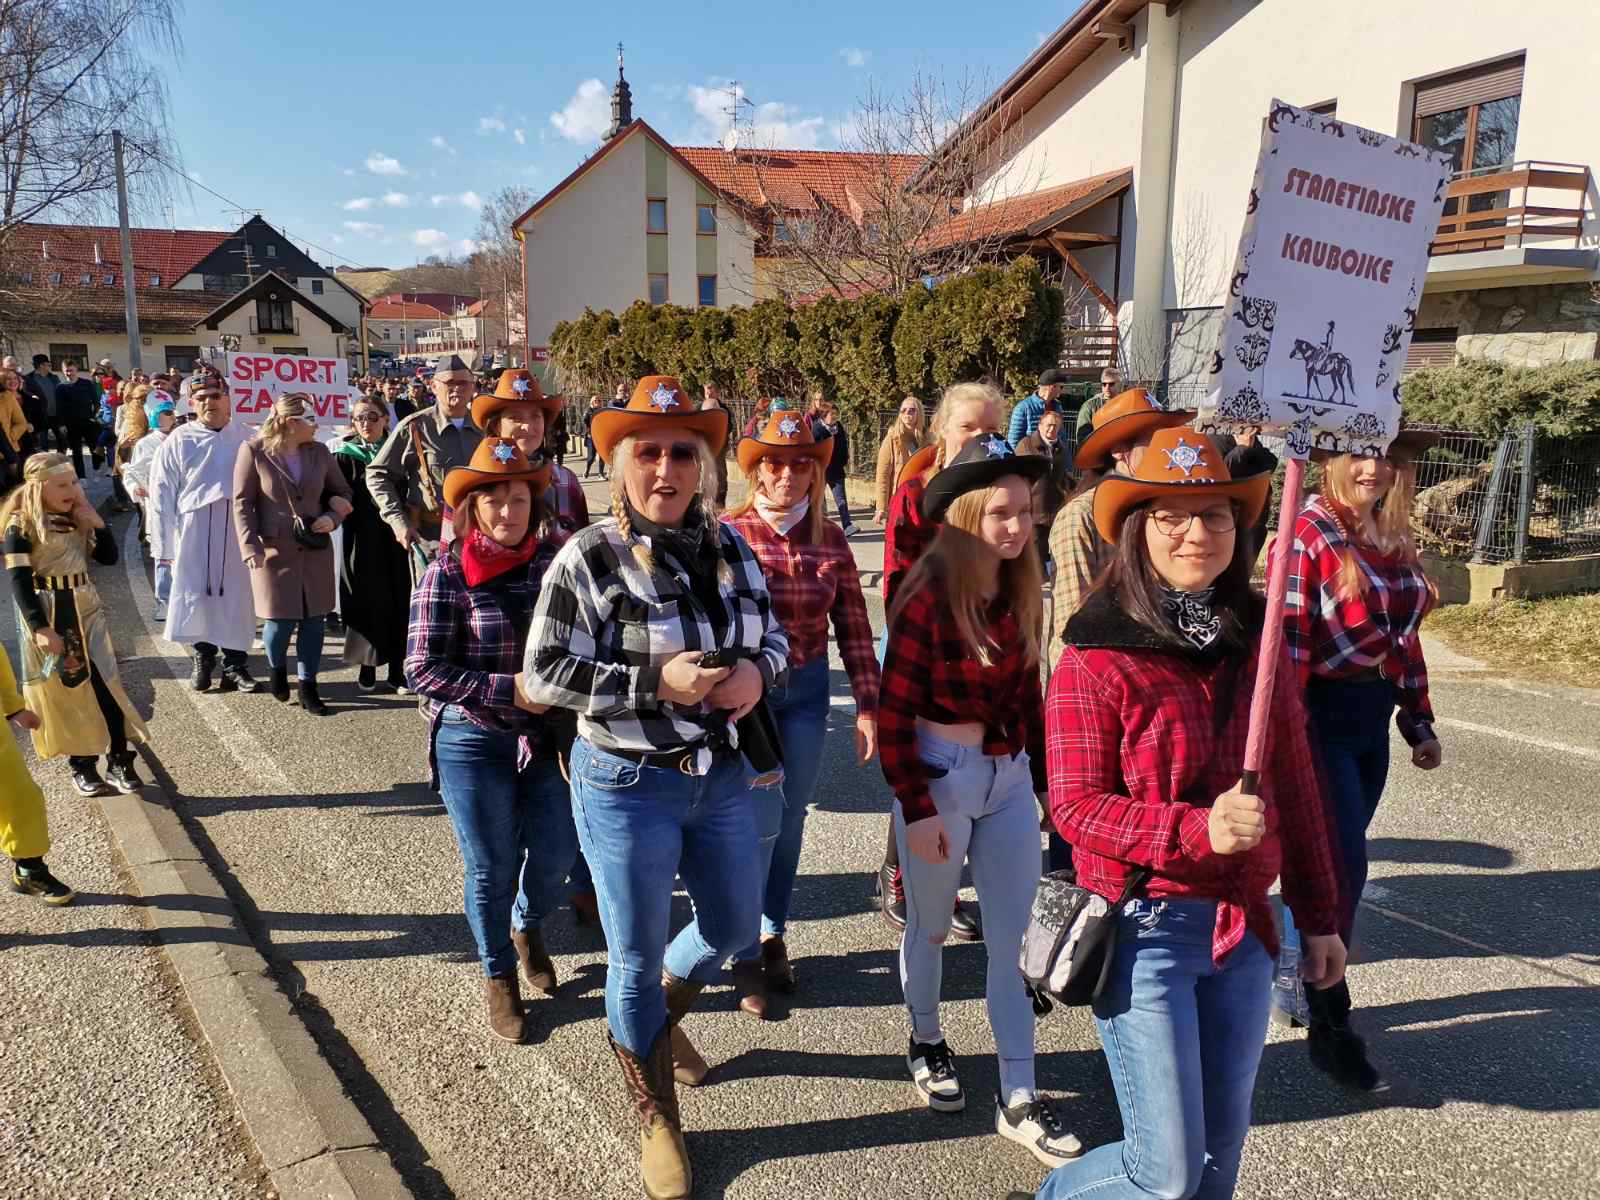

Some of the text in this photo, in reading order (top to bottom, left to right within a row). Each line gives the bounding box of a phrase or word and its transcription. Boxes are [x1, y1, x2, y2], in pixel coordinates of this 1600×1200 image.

[1283, 167, 1416, 224] STANETINSKE
[1281, 232, 1394, 284] KAUBOJKE
[232, 356, 337, 385] SPORT
[234, 388, 348, 419] ZA VE
